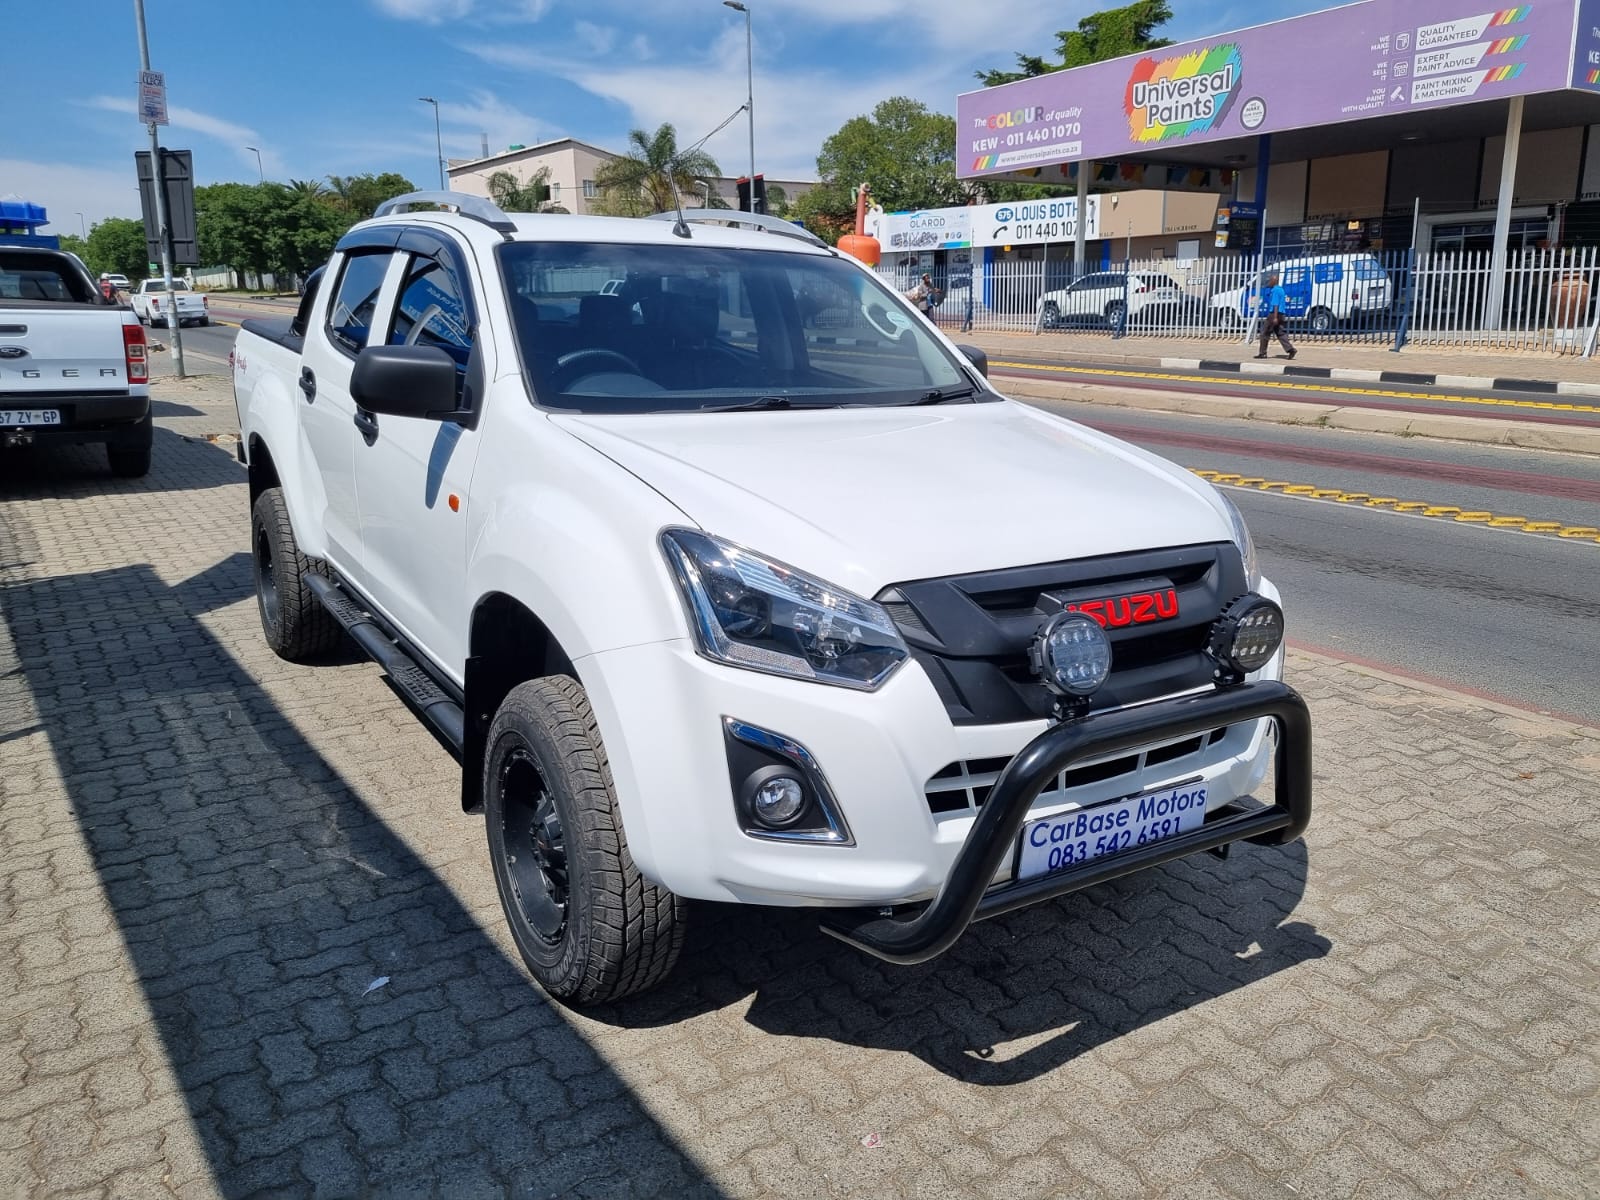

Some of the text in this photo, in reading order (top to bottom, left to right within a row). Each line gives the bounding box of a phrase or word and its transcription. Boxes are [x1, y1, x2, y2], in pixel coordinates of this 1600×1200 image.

[1419, 29, 1478, 46] GUARANTEED
[1420, 24, 1456, 38] QUALITY
[1417, 52, 1450, 65] EXPERT
[1417, 57, 1476, 73] PAINT ADVICE
[1133, 66, 1232, 107] Universal
[1415, 75, 1473, 91] PAINT MIXING
[1421, 85, 1467, 99] MATCHING
[974, 106, 1083, 130] The COLOUR of quality
[1147, 96, 1213, 126] Paints
[972, 137, 999, 153] KEW
[1006, 132, 1024, 146] 011
[1026, 128, 1049, 143] 440
[1051, 122, 1081, 139] 1070
[1001, 146, 1079, 163] www.universalpaints.co.za
[1015, 204, 1047, 222] LOUIS
[1016, 224, 1032, 239] 011
[1036, 222, 1058, 238] 440
[18, 411, 32, 424] ZY
[42, 411, 57, 423] GP
[1030, 789, 1206, 848] CarBase Motors
[1047, 816, 1181, 871] 083 542 6591
